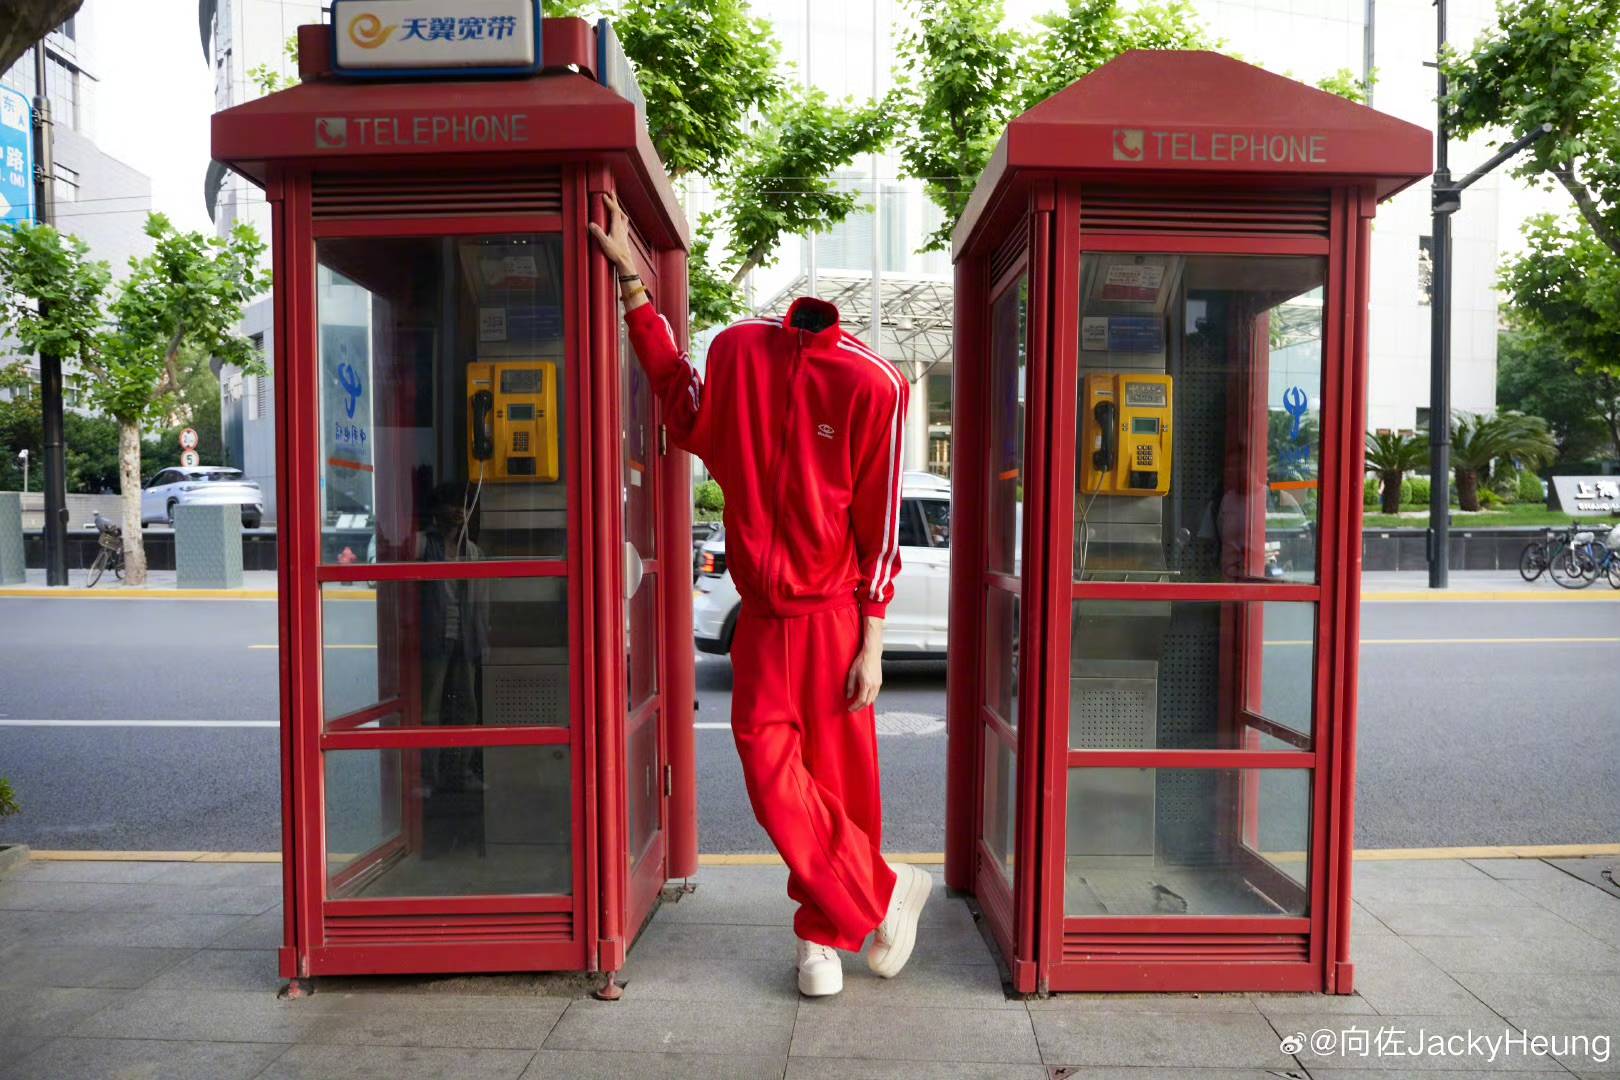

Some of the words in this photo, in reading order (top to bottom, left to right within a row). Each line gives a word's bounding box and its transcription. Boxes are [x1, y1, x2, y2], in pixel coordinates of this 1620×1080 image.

[400, 16, 517, 41] 天翼宽带
[353, 114, 529, 146] TELEPHONE
[1152, 131, 1327, 163] TELEPHONE
[186, 454, 193, 466] 5
